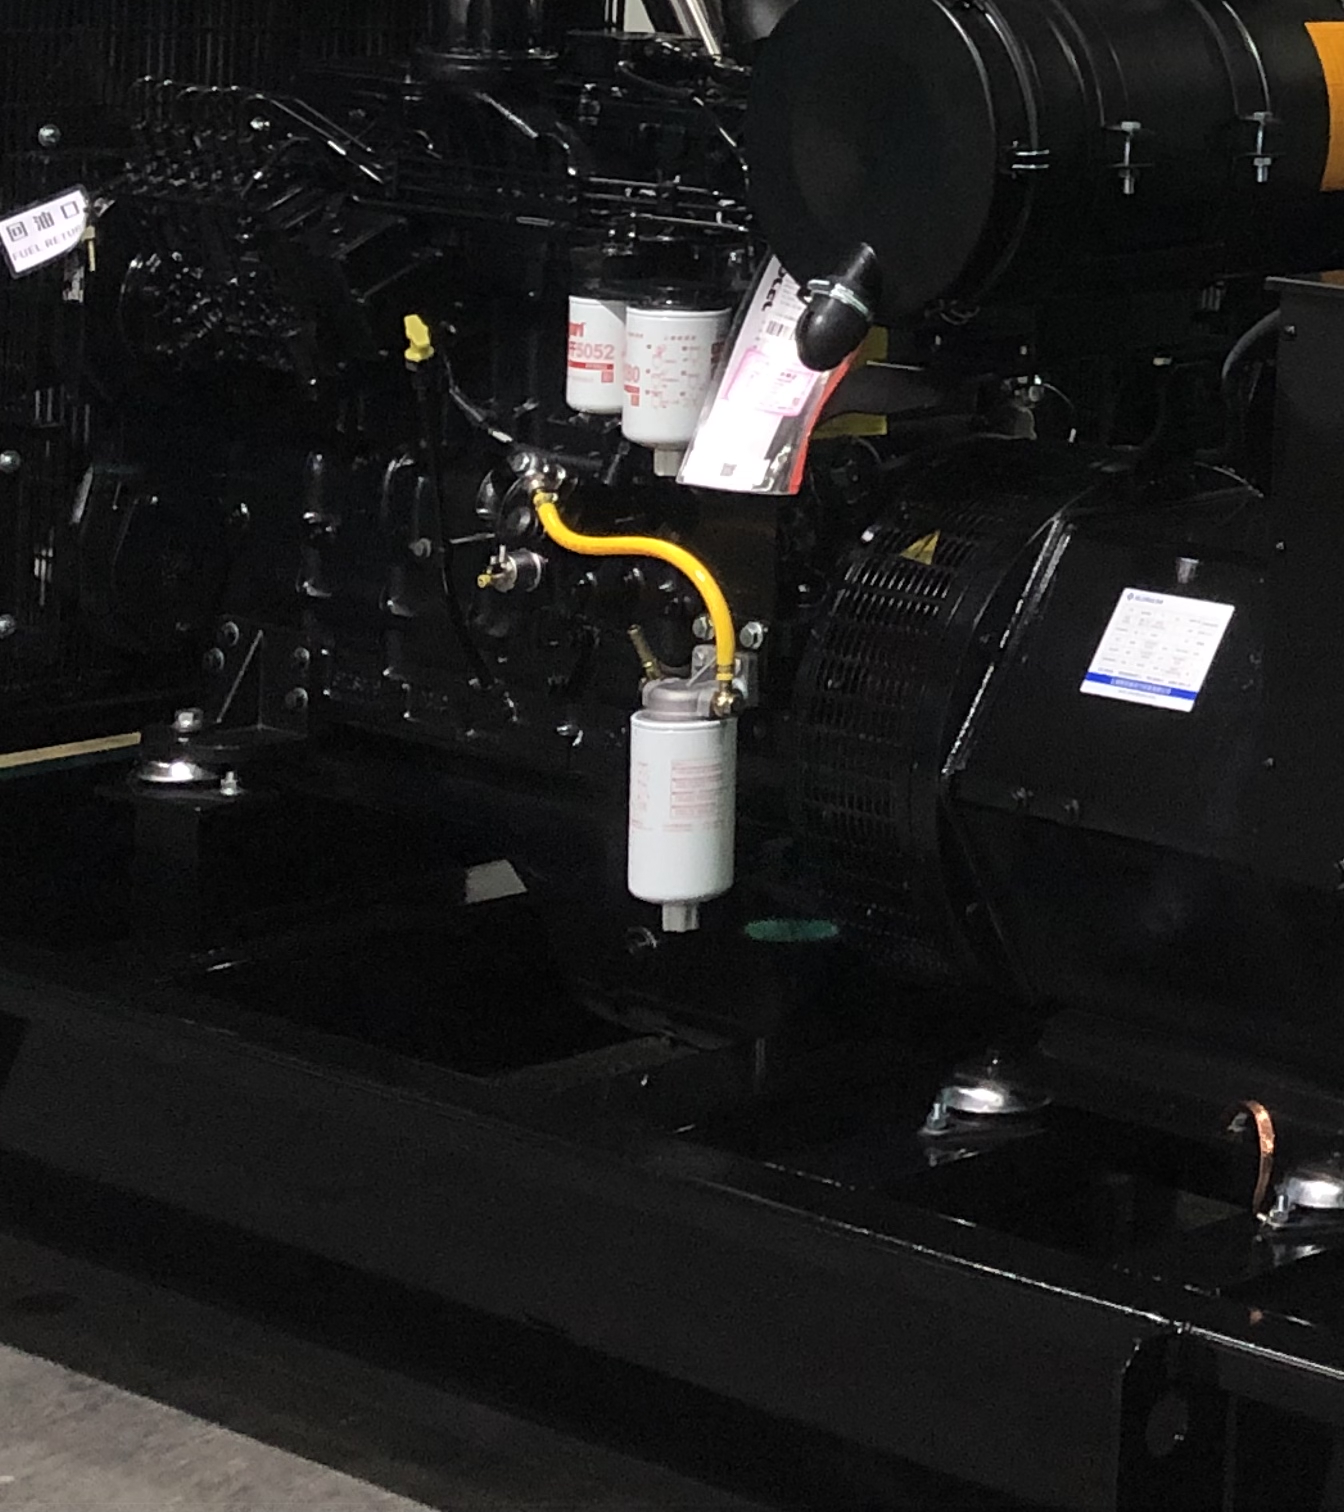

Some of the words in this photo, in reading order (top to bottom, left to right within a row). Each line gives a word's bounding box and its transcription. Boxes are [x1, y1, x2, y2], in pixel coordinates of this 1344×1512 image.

[6, 201, 80, 242] 回油口
[12, 244, 41, 261] FUEL
